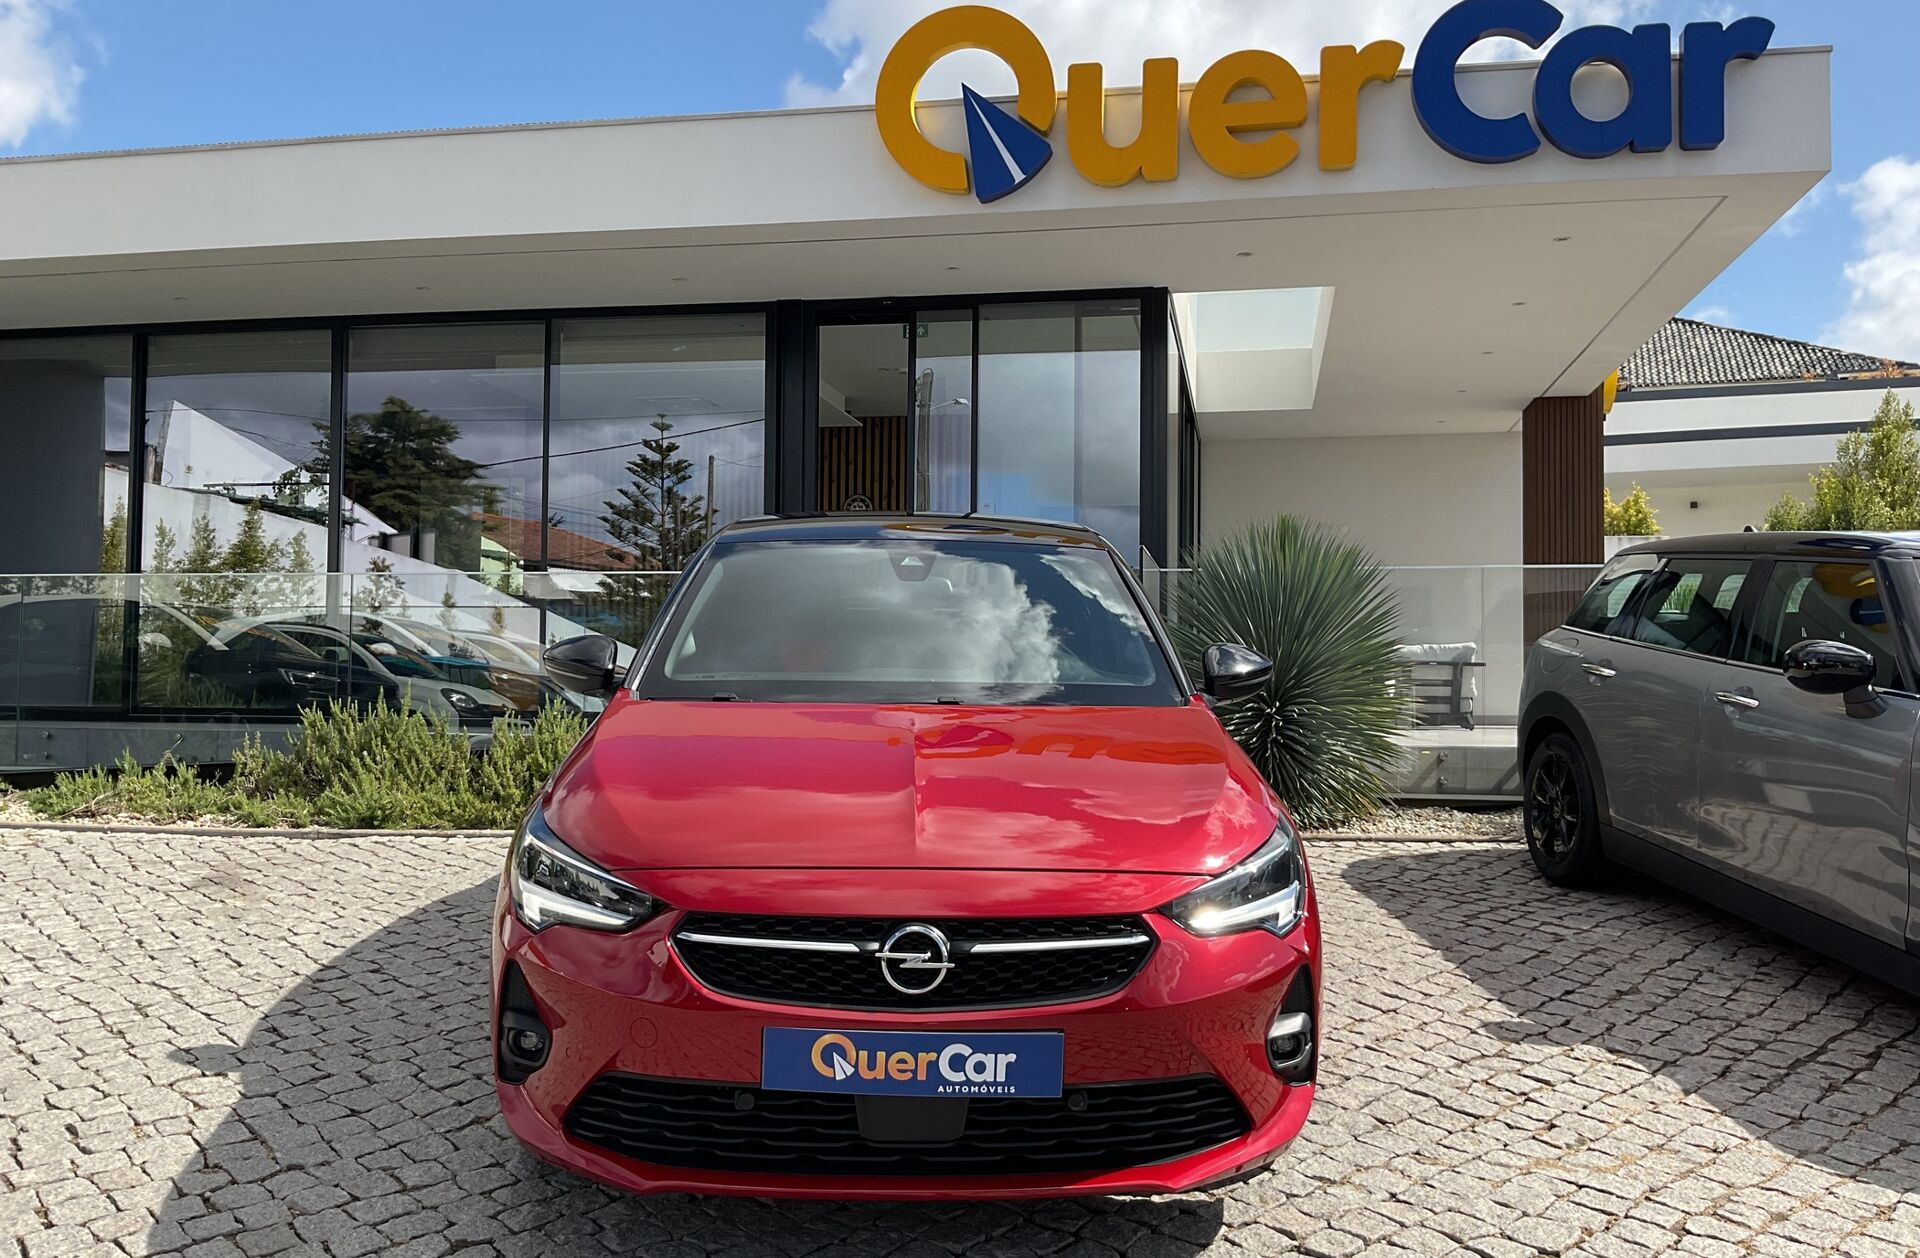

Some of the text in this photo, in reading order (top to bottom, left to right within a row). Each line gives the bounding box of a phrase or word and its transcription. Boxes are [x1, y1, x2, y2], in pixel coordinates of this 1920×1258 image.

[875, 0, 1774, 203] QuerCar
[811, 1033, 1017, 1082] QuerCar
[937, 1084, 1017, 1094] AUTOMÓVEIS
